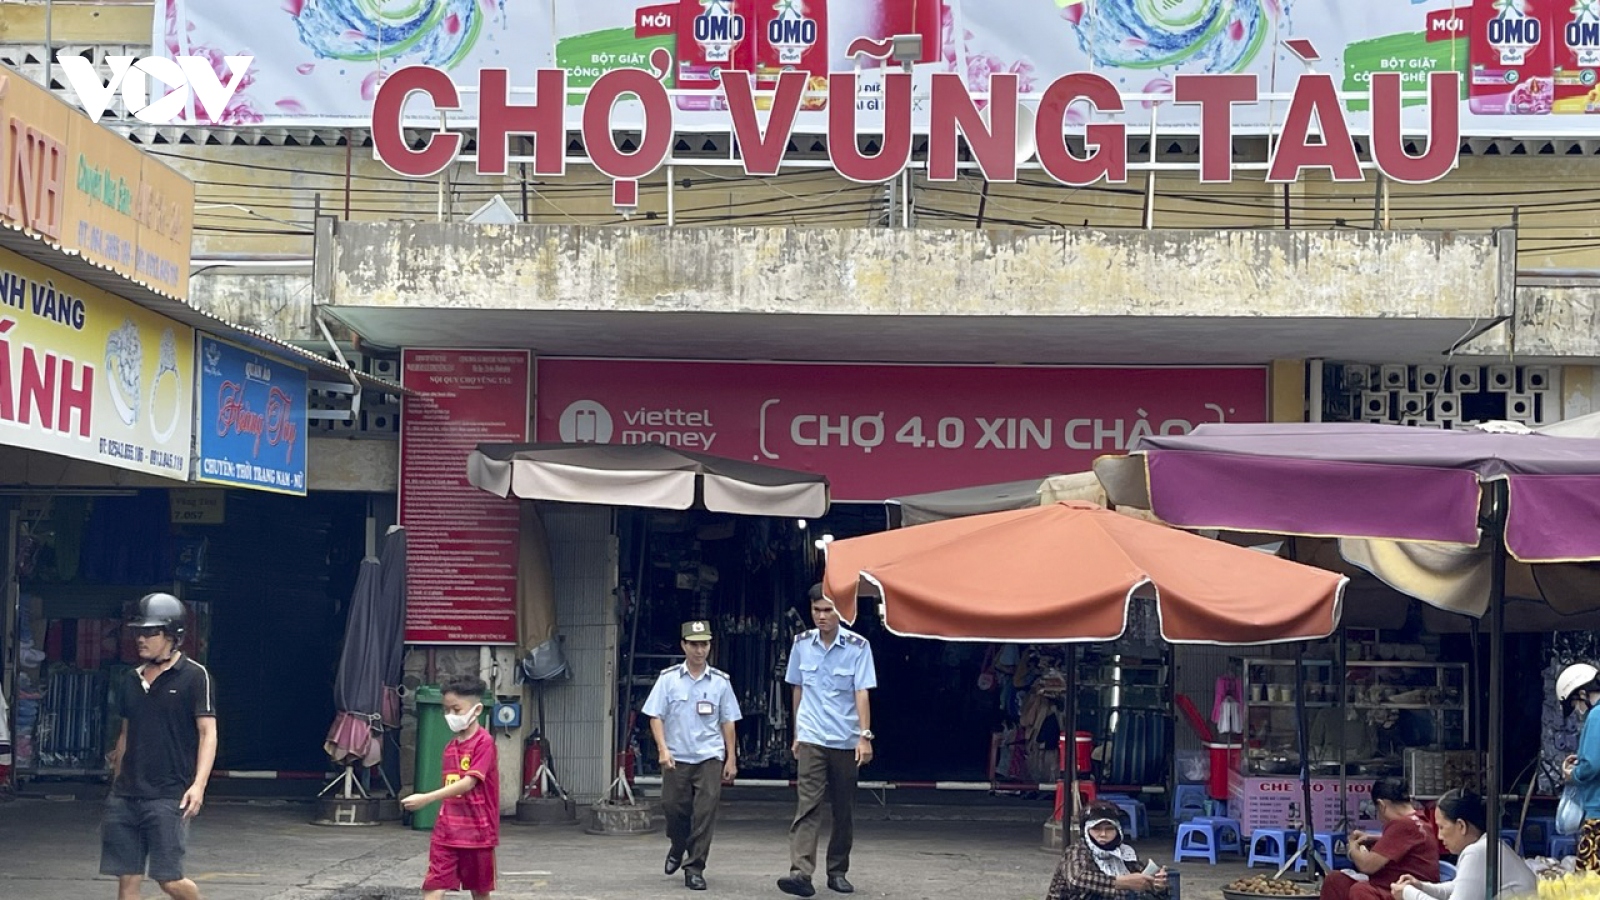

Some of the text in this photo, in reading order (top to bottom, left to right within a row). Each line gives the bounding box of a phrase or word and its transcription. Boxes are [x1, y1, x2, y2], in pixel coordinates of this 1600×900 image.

[640, 13, 671, 28] MỚI
[695, 15, 743, 41] OMO
[769, 19, 816, 44] OMO
[1489, 18, 1540, 44] OMO
[591, 51, 646, 66] BỘT GIẶT
[1380, 56, 1438, 71] BỘT GIẶT
[566, 65, 600, 77] CÔNG
[1353, 70, 1426, 85] CÔ GHỆ
[371, 36, 1461, 207] CHỢ VŨNG TÀU
[0, 112, 67, 242] NH
[31, 280, 86, 331] VÀNG
[624, 407, 713, 427] viettel
[621, 431, 717, 451] money
[790, 411, 885, 453] CHỢ
[894, 415, 965, 449] 4.0
[974, 418, 1052, 450] XIN
